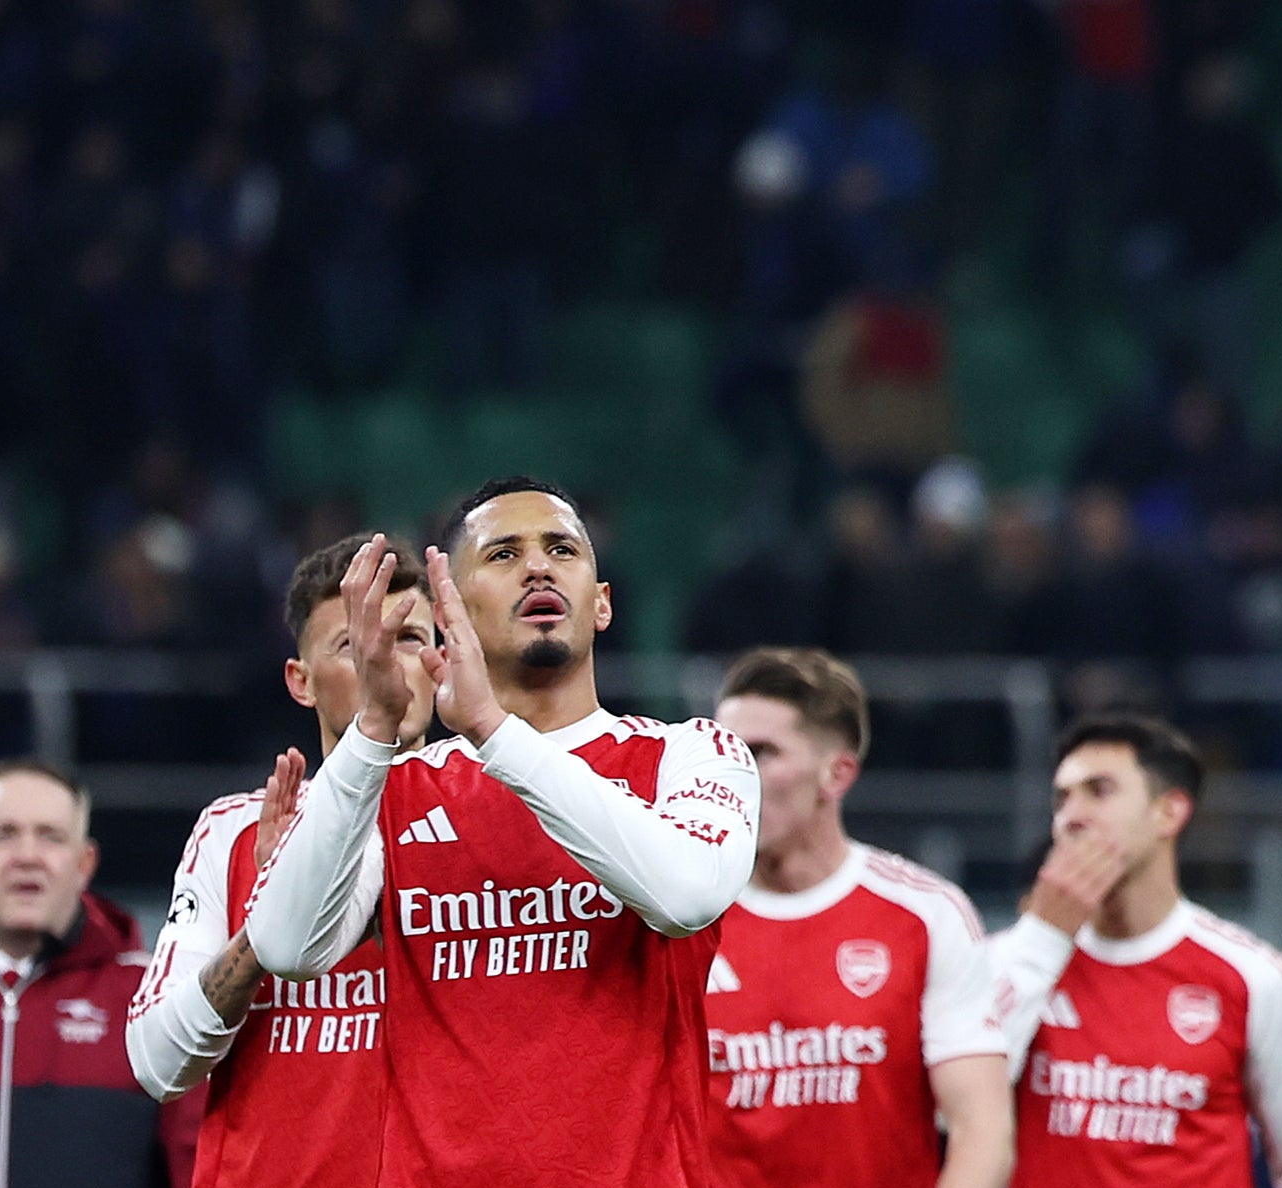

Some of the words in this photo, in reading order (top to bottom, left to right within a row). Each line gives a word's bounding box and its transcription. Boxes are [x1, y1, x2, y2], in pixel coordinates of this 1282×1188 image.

[694, 777, 746, 809] VISIT
[397, 876, 625, 937] Emirates
[431, 939, 479, 982] FLY
[486, 929, 590, 977] BETTER
[268, 1014, 313, 1054] FLY
[317, 1011, 382, 1054] BETT
[707, 1019, 887, 1073] Emirates
[1030, 1052, 1209, 1111] Emirates
